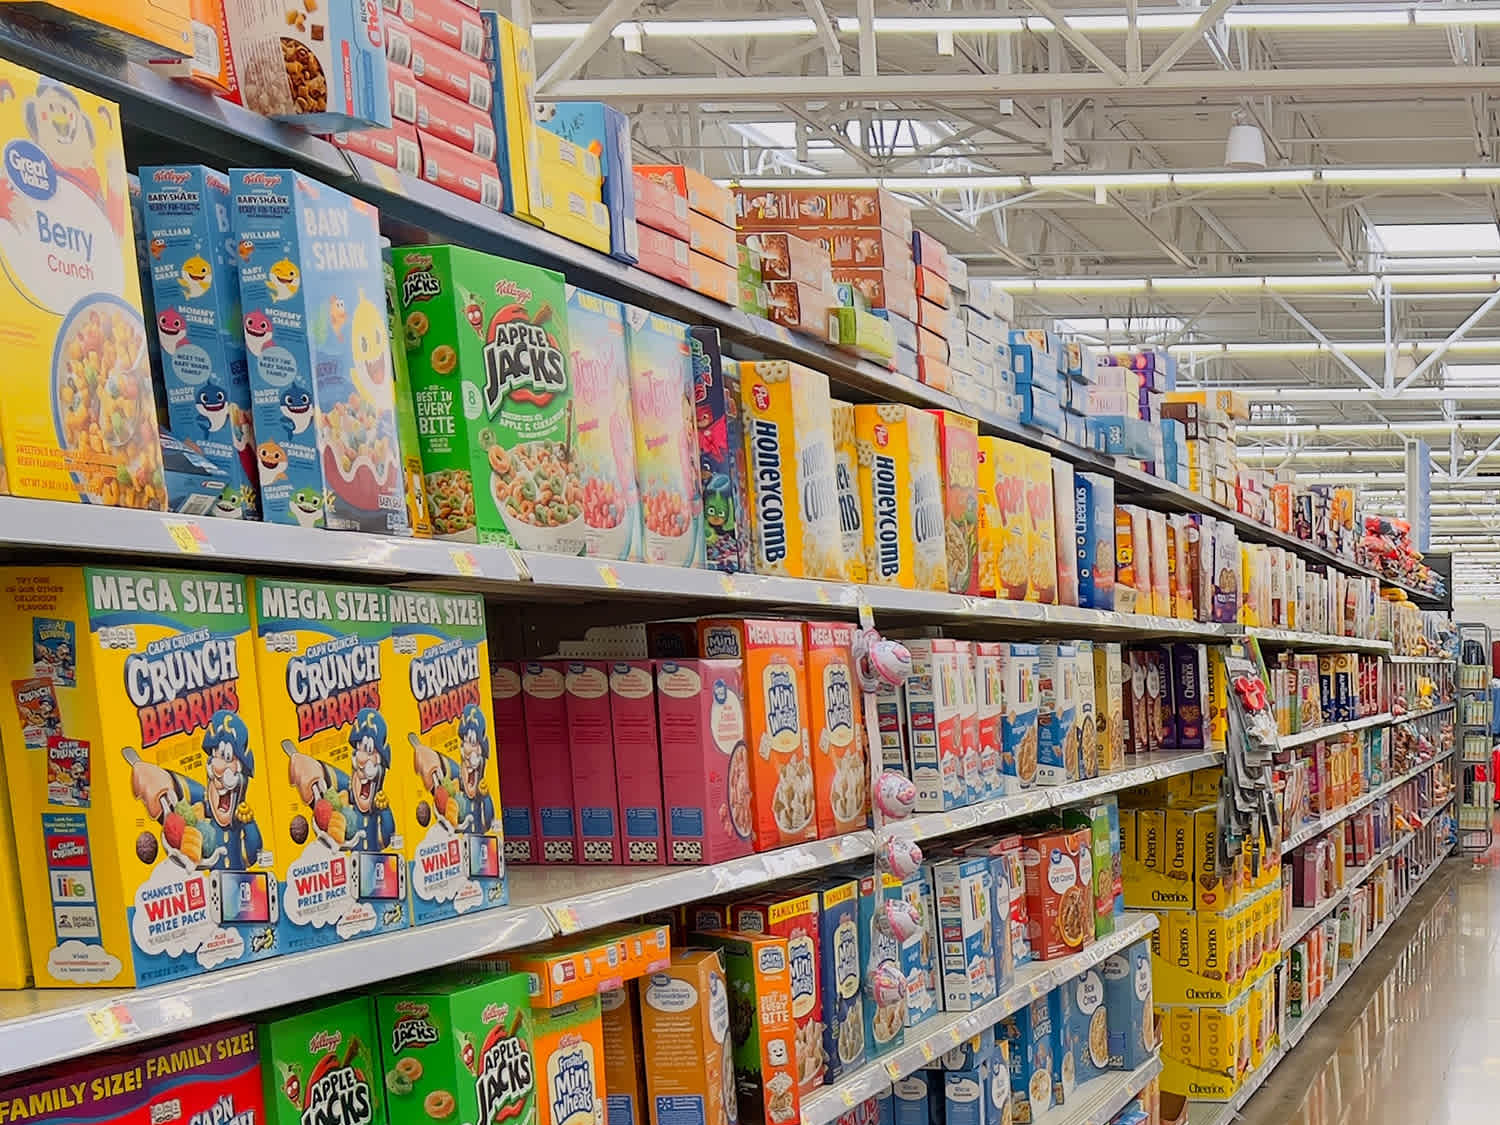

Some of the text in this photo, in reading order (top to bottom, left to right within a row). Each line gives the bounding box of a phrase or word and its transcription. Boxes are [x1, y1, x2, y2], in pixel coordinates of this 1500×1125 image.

[8, 149, 50, 180] Great
[20, 170, 50, 191] Value
[152, 227, 191, 238] WILLIAM
[241, 231, 280, 240] WILLIAM
[304, 208, 348, 237] BABY
[38, 211, 93, 263] Berry
[47, 254, 94, 282] Crunch
[312, 241, 369, 272] SHARK
[178, 305, 215, 317] MOMMY
[185, 315, 214, 326] SHARK
[265, 308, 302, 320] MOMMY
[272, 317, 301, 328] SHARK
[496, 323, 546, 348] APPLE
[485, 347, 565, 410] JACKS
[416, 391, 452, 403] BEST IN
[417, 402, 453, 416] EVERY
[419, 416, 455, 434] BITE
[92, 576, 178, 612] MEGA
[181, 580, 244, 614] SIZE!
[262, 586, 387, 622] MEGA SIZE!
[389, 596, 484, 627] MEGA SIZE!
[126, 640, 239, 707] CRUNCH
[289, 644, 381, 705] CRUNCH
[409, 645, 480, 701] CRUNCH
[298, 681, 380, 741] BERRIES
[418, 683, 480, 736] BERRIES
[770, 686, 794, 709] Mini
[140, 681, 239, 748] BERRIES
[421, 851, 449, 873] WIN
[1173, 828, 1185, 868] Cheerios
[292, 861, 329, 878] CHANCE TO
[423, 866, 461, 883] PRIZE PACK
[56, 876, 87, 898] life
[141, 882, 184, 900] CHANCE TO
[295, 874, 329, 897] WIN
[298, 886, 347, 907] PRIZE PACK
[1151, 890, 1188, 902] Cheerios
[144, 894, 185, 922] WIN
[148, 911, 207, 935] PRIZE PACK
[1179, 927, 1188, 967] Cheerios
[1206, 928, 1216, 967] Cheerios
[1186, 988, 1223, 1000] Cheerios
[146, 1033, 254, 1080] FAMILY SIZE!
[485, 1037, 520, 1075] APPLE
[311, 1067, 357, 1112] APPLE
[556, 1065, 590, 1096] Mini
[1189, 1082, 1224, 1094] Cheerios
[0, 1068, 142, 1124] FAMILY SIZE!
[555, 1091, 593, 1125] Wheats
